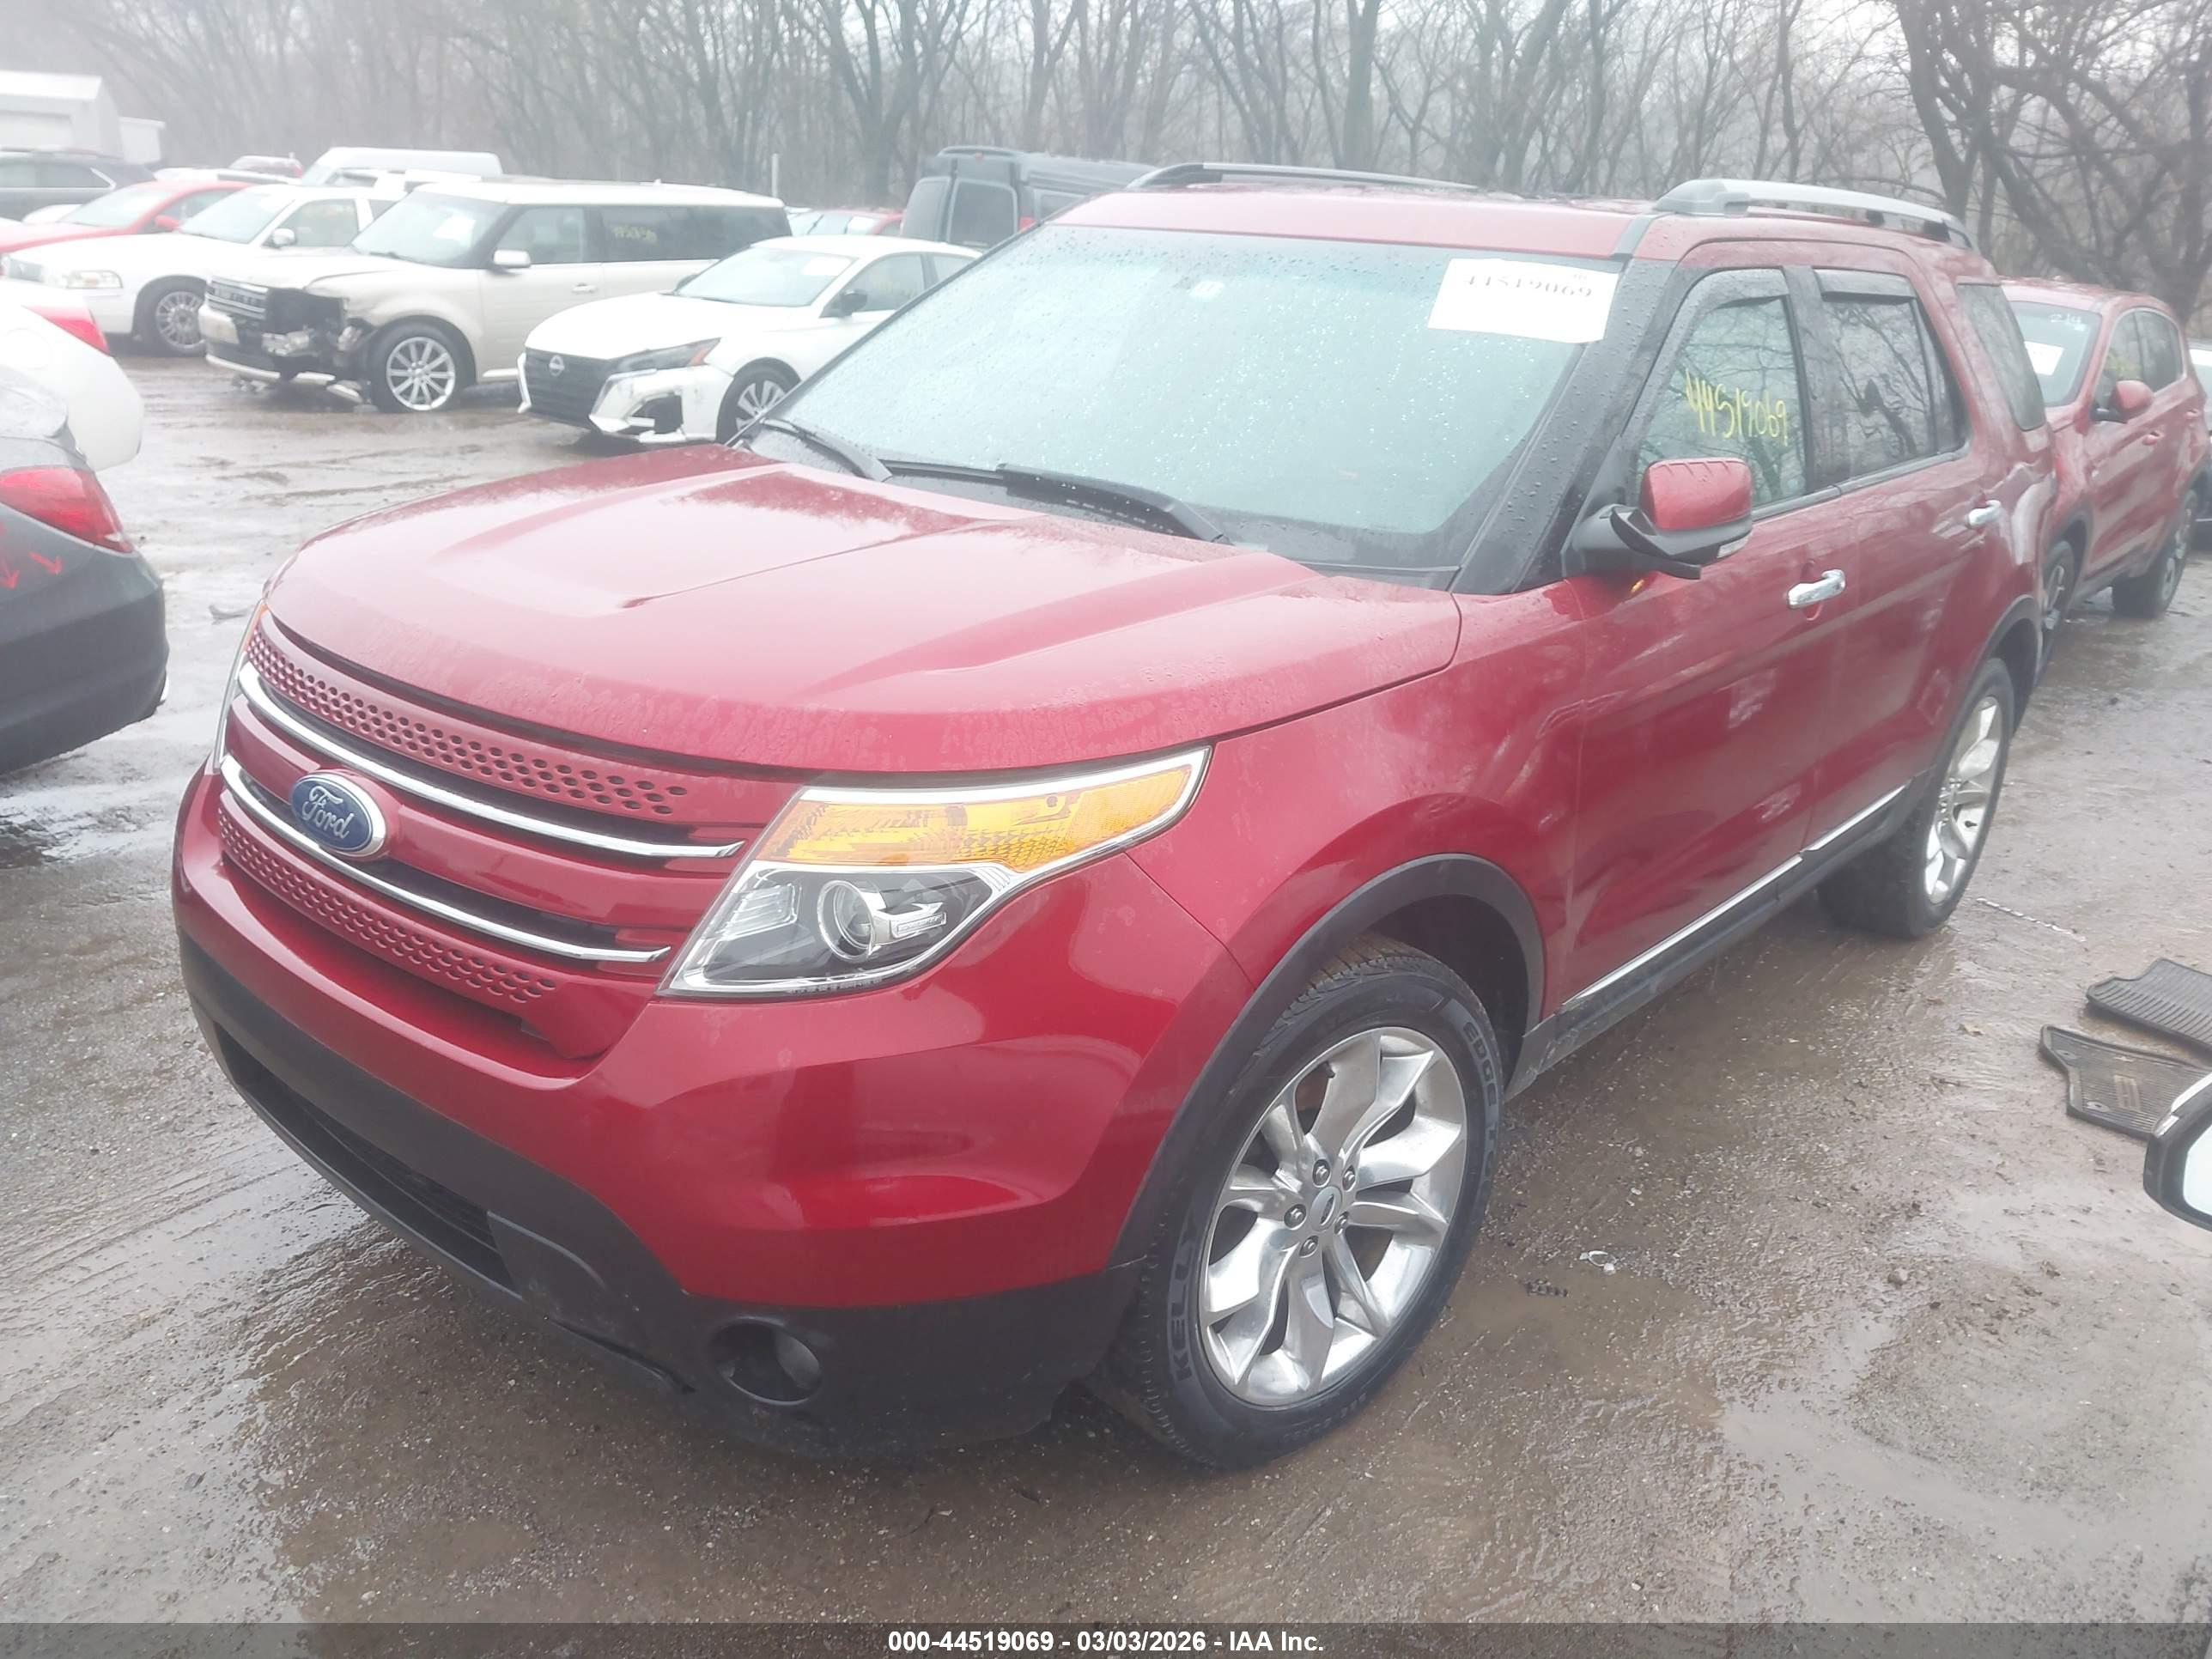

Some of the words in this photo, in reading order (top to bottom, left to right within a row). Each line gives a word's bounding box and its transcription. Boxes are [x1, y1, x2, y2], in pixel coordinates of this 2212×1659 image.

[1685, 368, 1789, 447] 44519069
[302, 786, 355, 839] Ford
[1462, 1021, 1498, 1108] EDGE
[1170, 1209, 1198, 1382] KELLY
